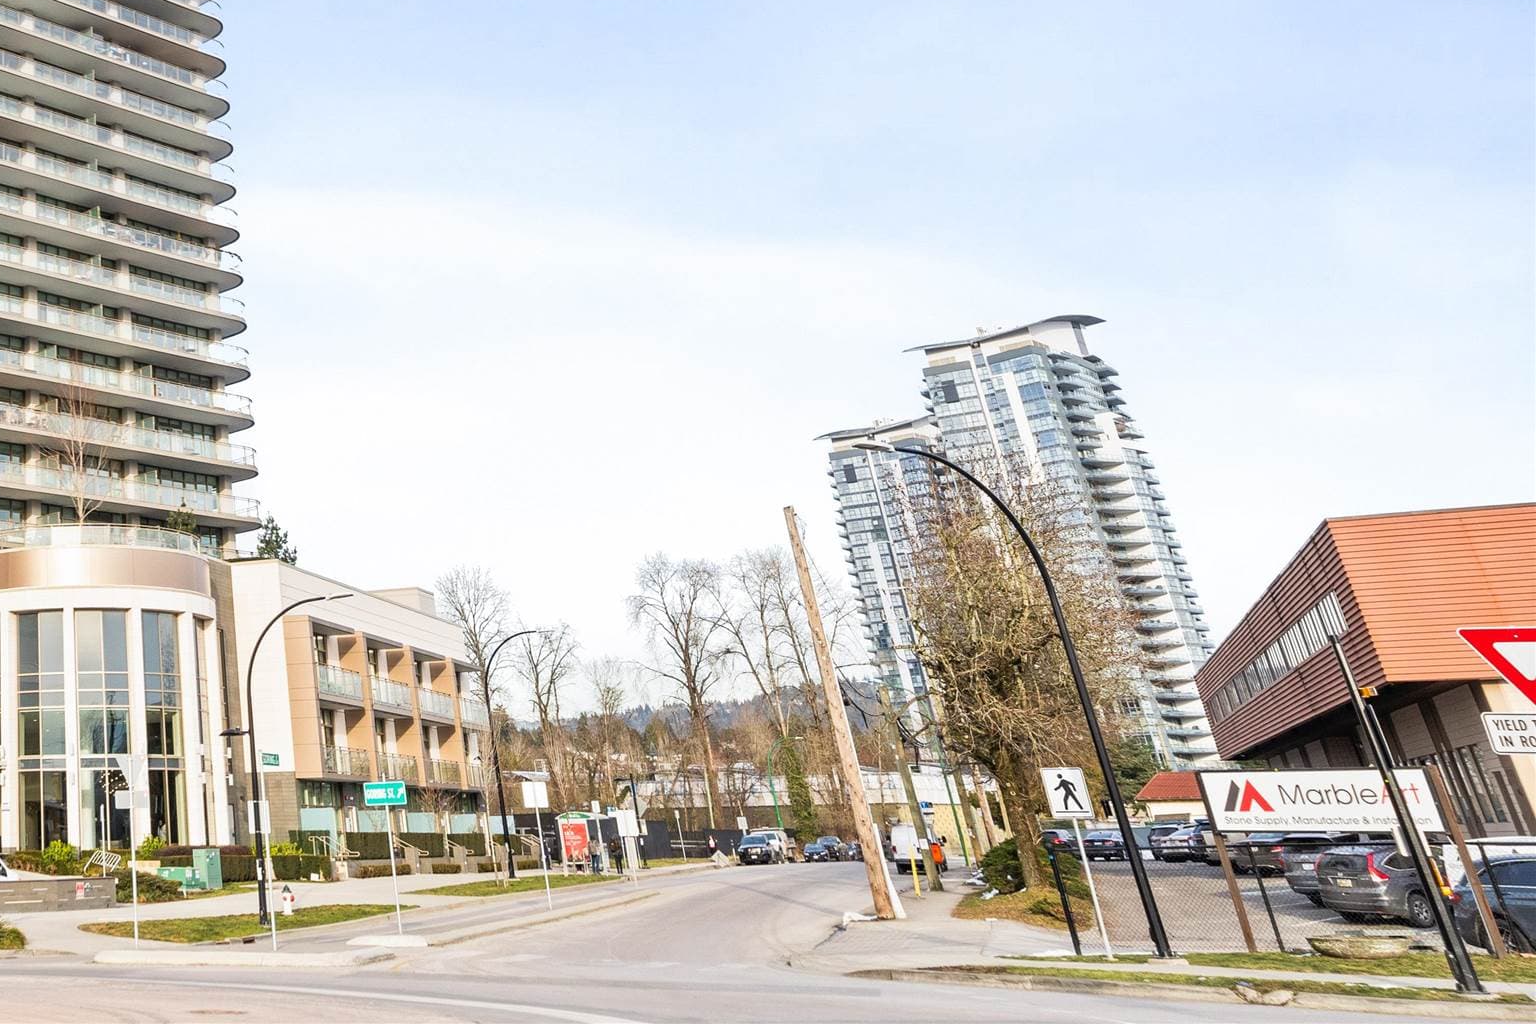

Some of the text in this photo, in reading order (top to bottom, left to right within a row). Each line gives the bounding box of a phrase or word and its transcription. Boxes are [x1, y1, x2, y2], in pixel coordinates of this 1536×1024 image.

[1492, 719, 1527, 731] YIELD
[1498, 735, 1514, 747] IN
[1224, 816, 1253, 825] Stone
[1292, 816, 1360, 825] Manufacture
[1362, 816, 1370, 825] &
